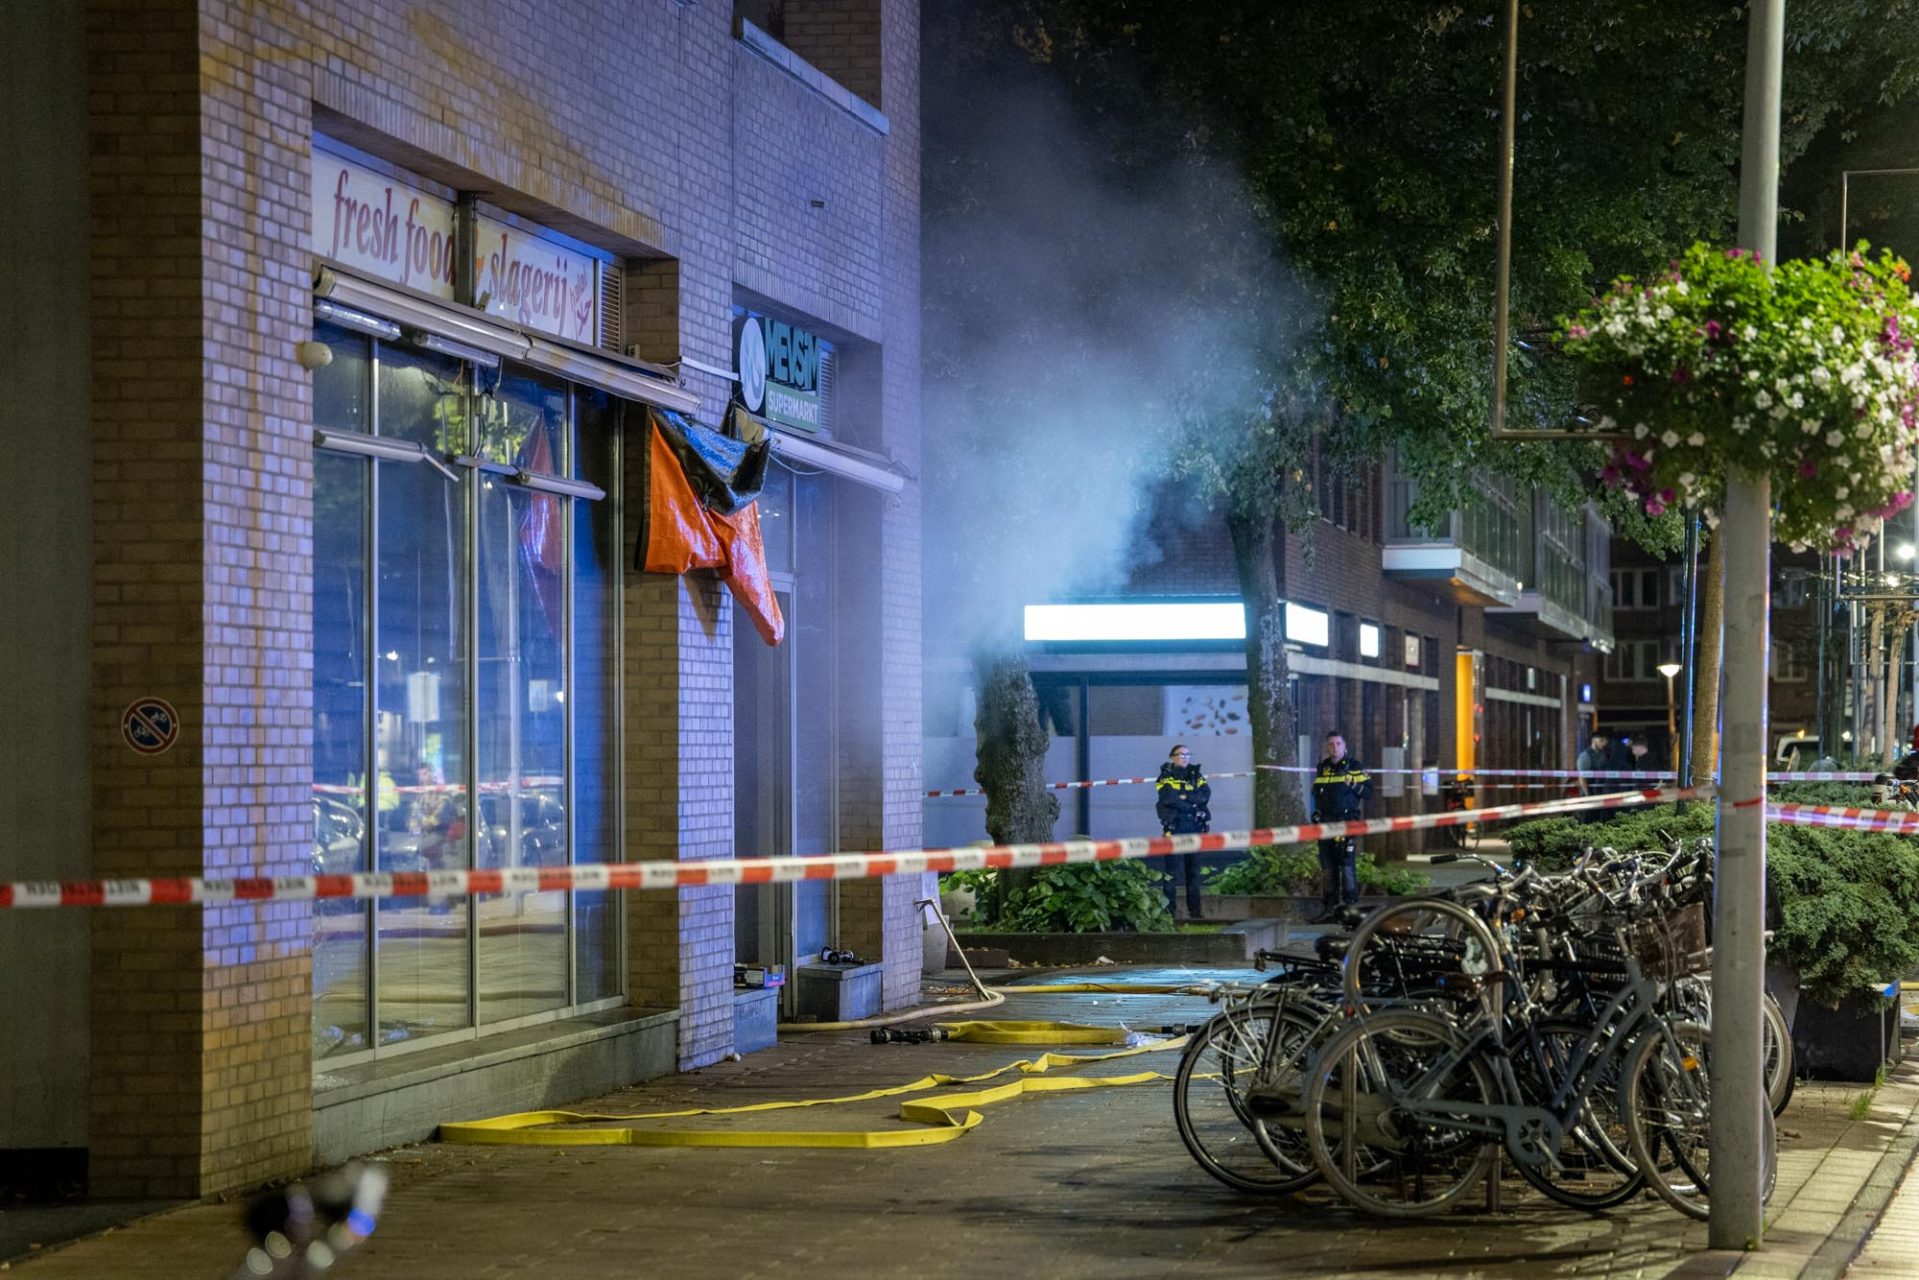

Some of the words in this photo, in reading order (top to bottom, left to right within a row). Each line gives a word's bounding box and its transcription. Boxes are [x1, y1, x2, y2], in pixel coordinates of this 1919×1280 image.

[328, 169, 399, 261] fresh
[489, 232, 568, 336] slagerij
[767, 390, 818, 424] SUPERMARKT
